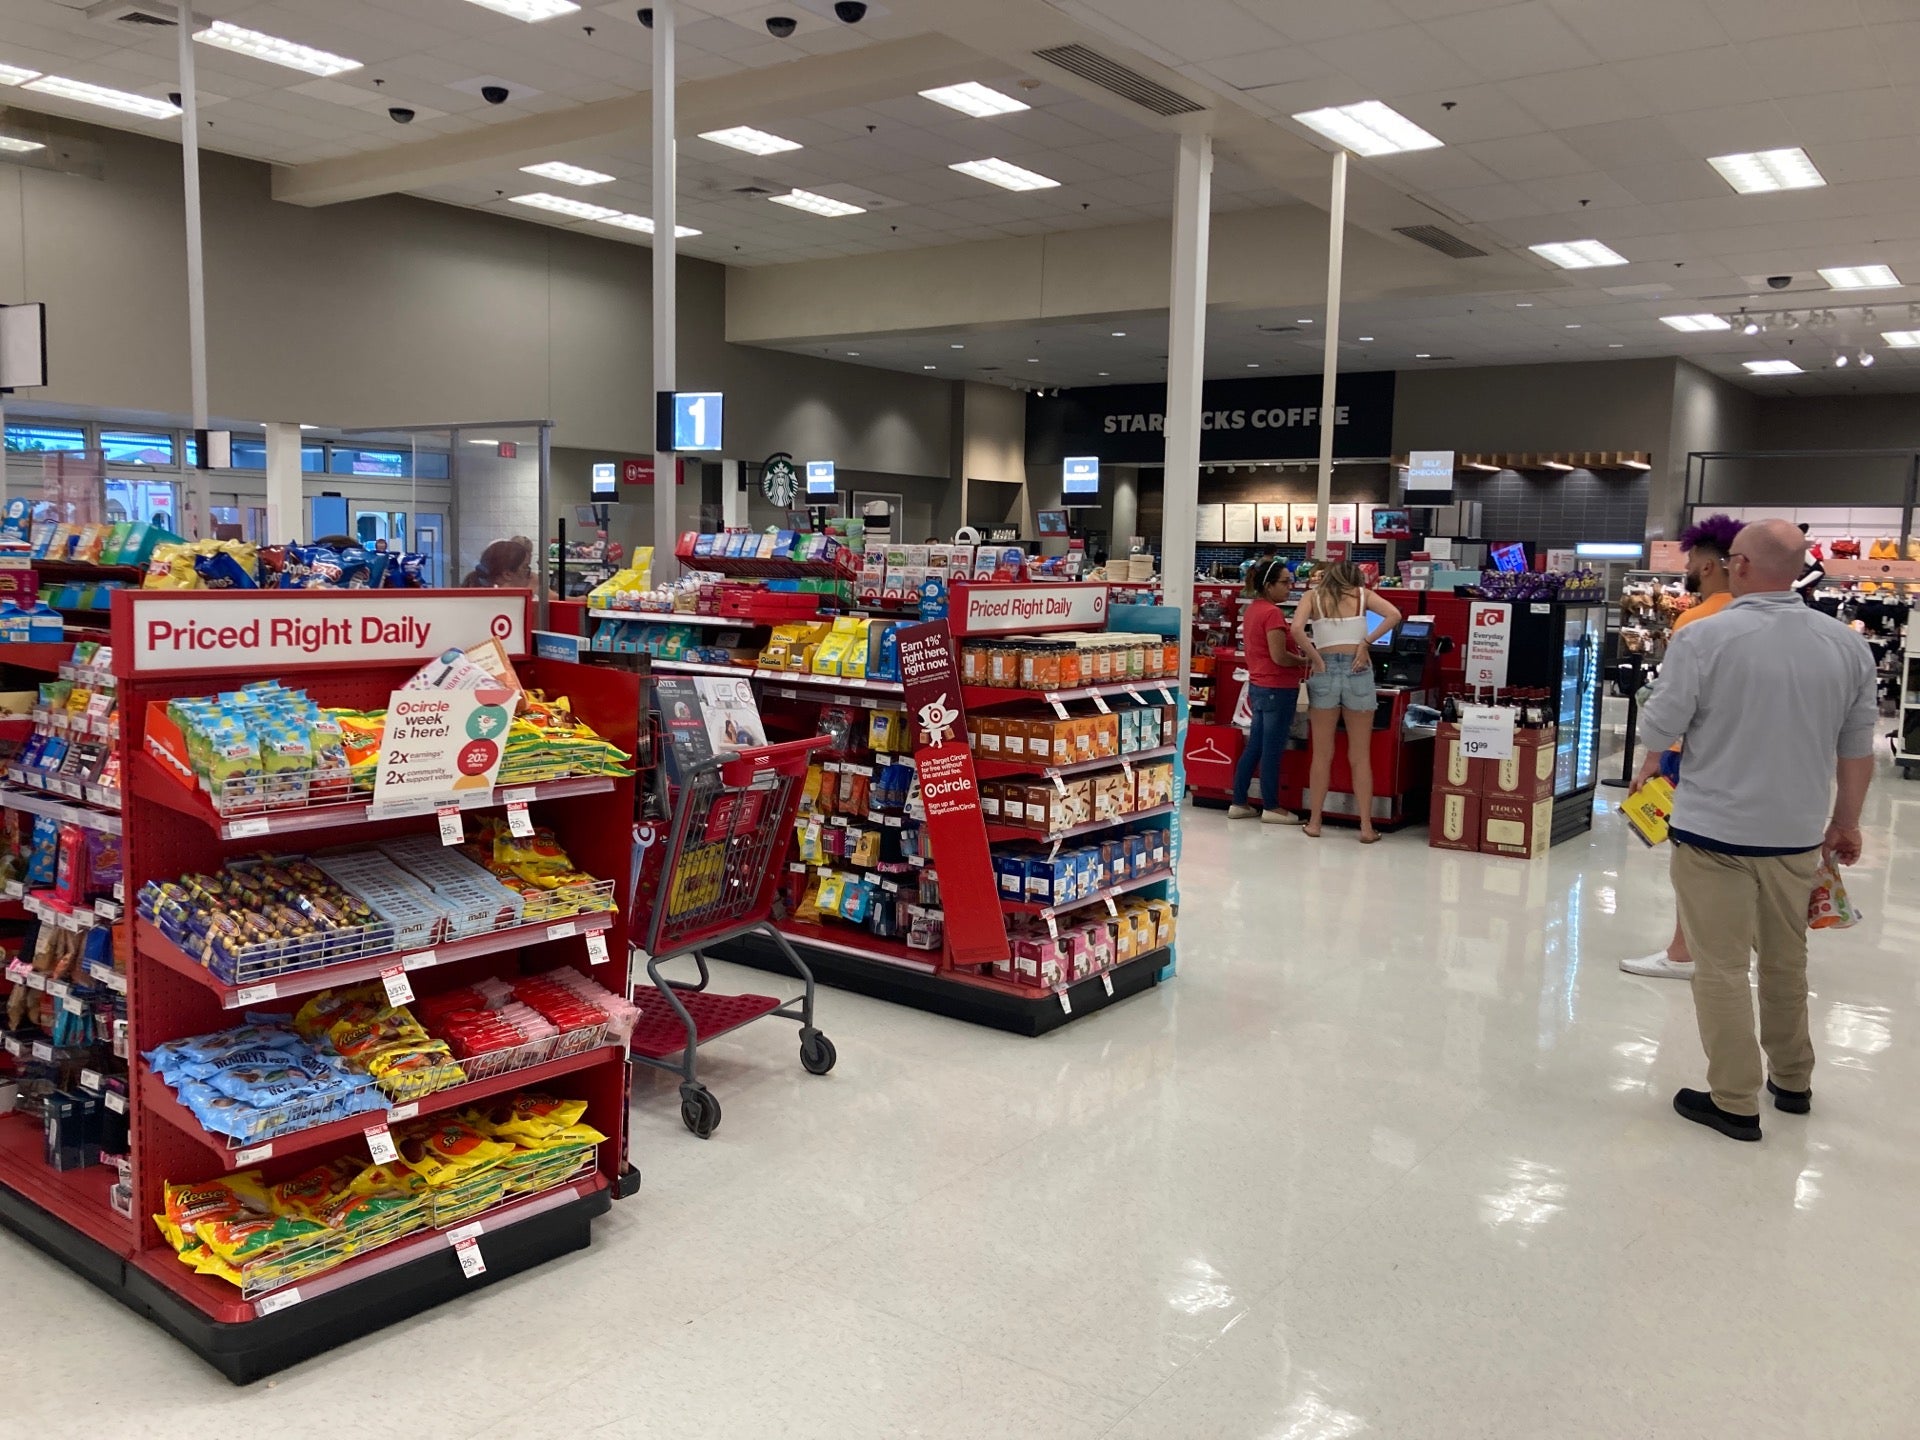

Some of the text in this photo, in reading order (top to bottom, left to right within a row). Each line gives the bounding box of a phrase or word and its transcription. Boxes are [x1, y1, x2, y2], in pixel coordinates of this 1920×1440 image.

[688, 397, 706, 446] 1
[1103, 409, 1246, 434] STARCKS
[1410, 469, 1452, 477] CHECKOUT
[969, 596, 1072, 620] Priced Right Daily
[148, 616, 431, 652] Priced Right Daily
[1473, 631, 1504, 641] Everyday
[901, 641, 923, 653] Earn
[760, 656, 781, 666] Ricola
[903, 647, 949, 665] right here,
[904, 662, 926, 676] right
[926, 658, 949, 670] now.
[410, 700, 450, 713] circle
[405, 713, 443, 725] week
[393, 725, 450, 739] is here!
[388, 750, 409, 765] 2x
[932, 757, 950, 765] Target
[385, 768, 445, 785] 2x community
[406, 776, 433, 784] support
[937, 777, 971, 794] circle
